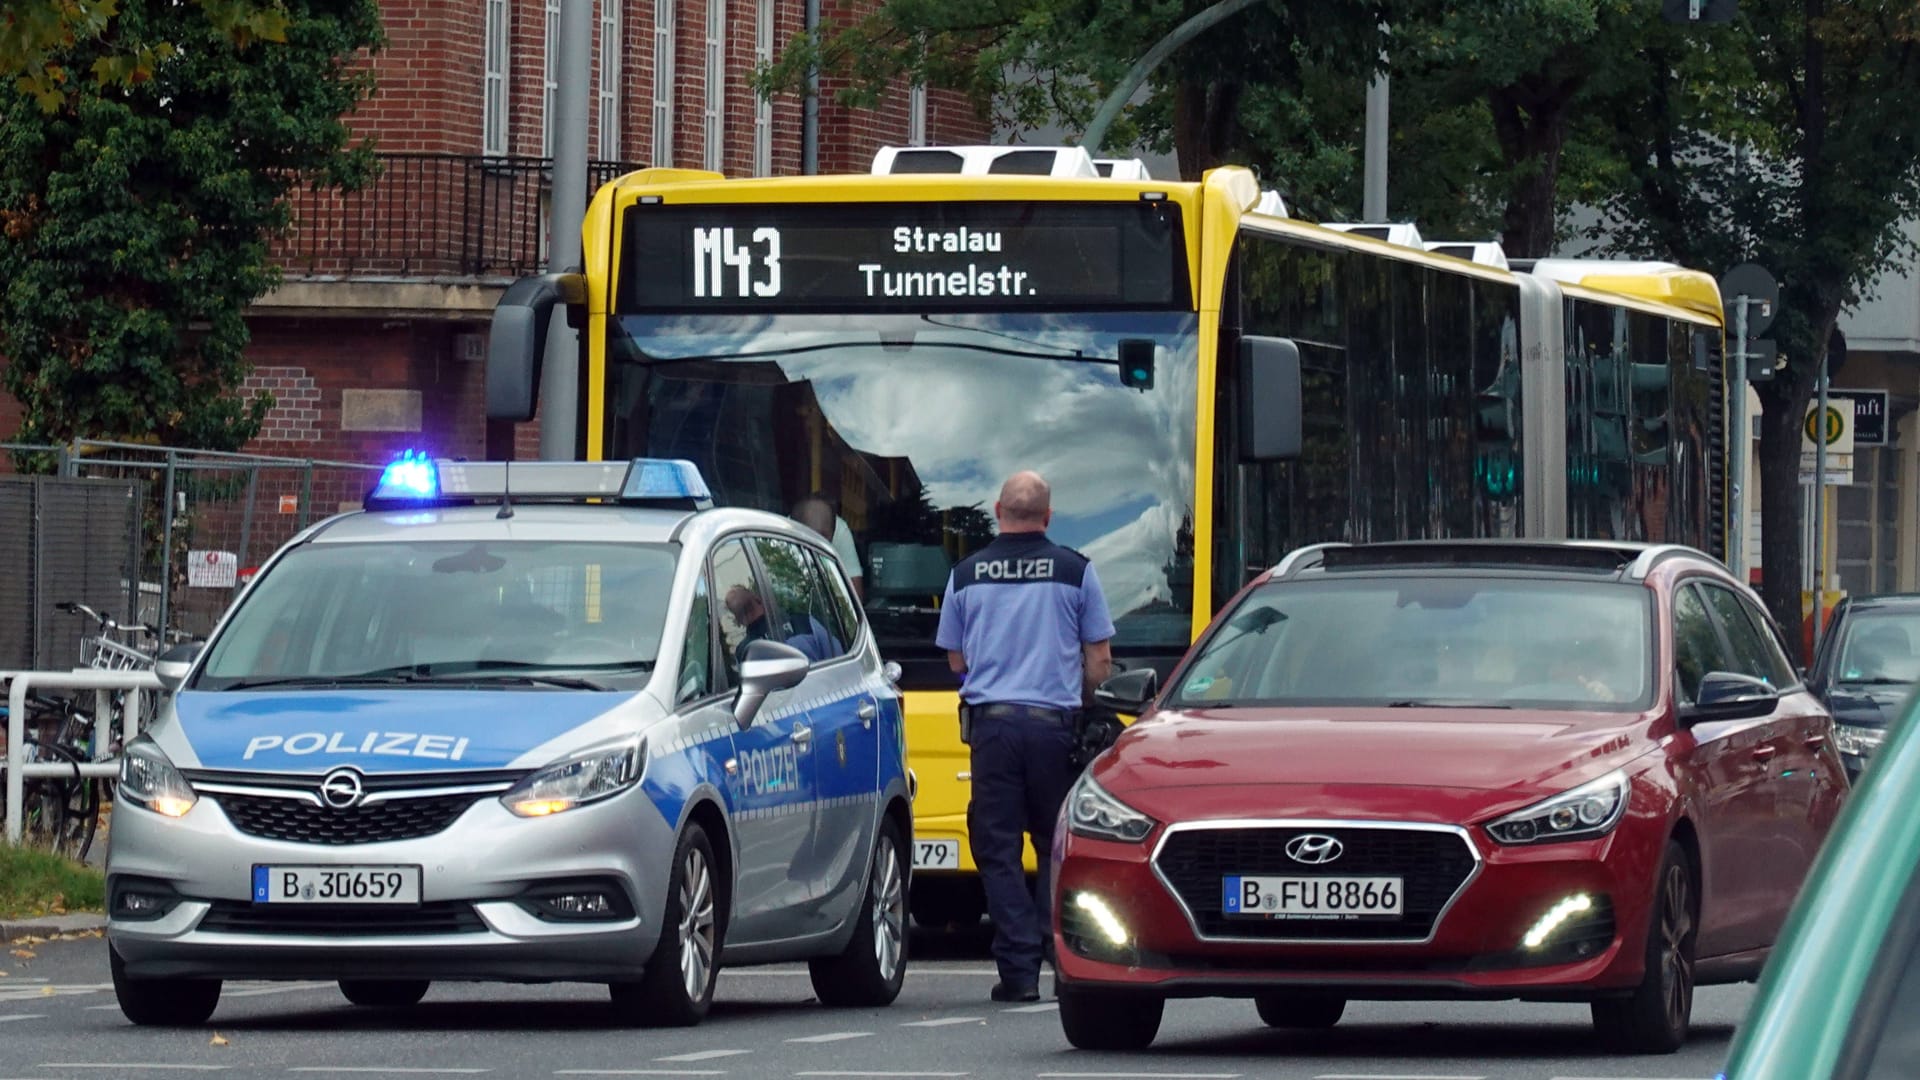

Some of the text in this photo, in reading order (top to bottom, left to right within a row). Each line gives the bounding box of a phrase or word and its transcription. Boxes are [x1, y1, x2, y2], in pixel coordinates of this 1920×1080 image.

[894, 227, 1002, 252] Stralau
[694, 228, 781, 297] M43
[858, 264, 1036, 297] Tunnelstr.
[974, 558, 1054, 580] POLIZEI
[243, 732, 469, 761] POLIZEI
[739, 744, 799, 796] POLIZEI
[283, 872, 299, 898] B
[318, 872, 403, 898] 30659
[1243, 881, 1261, 908] B
[1281, 881, 1319, 909] FU
[1326, 881, 1397, 909] 8866
